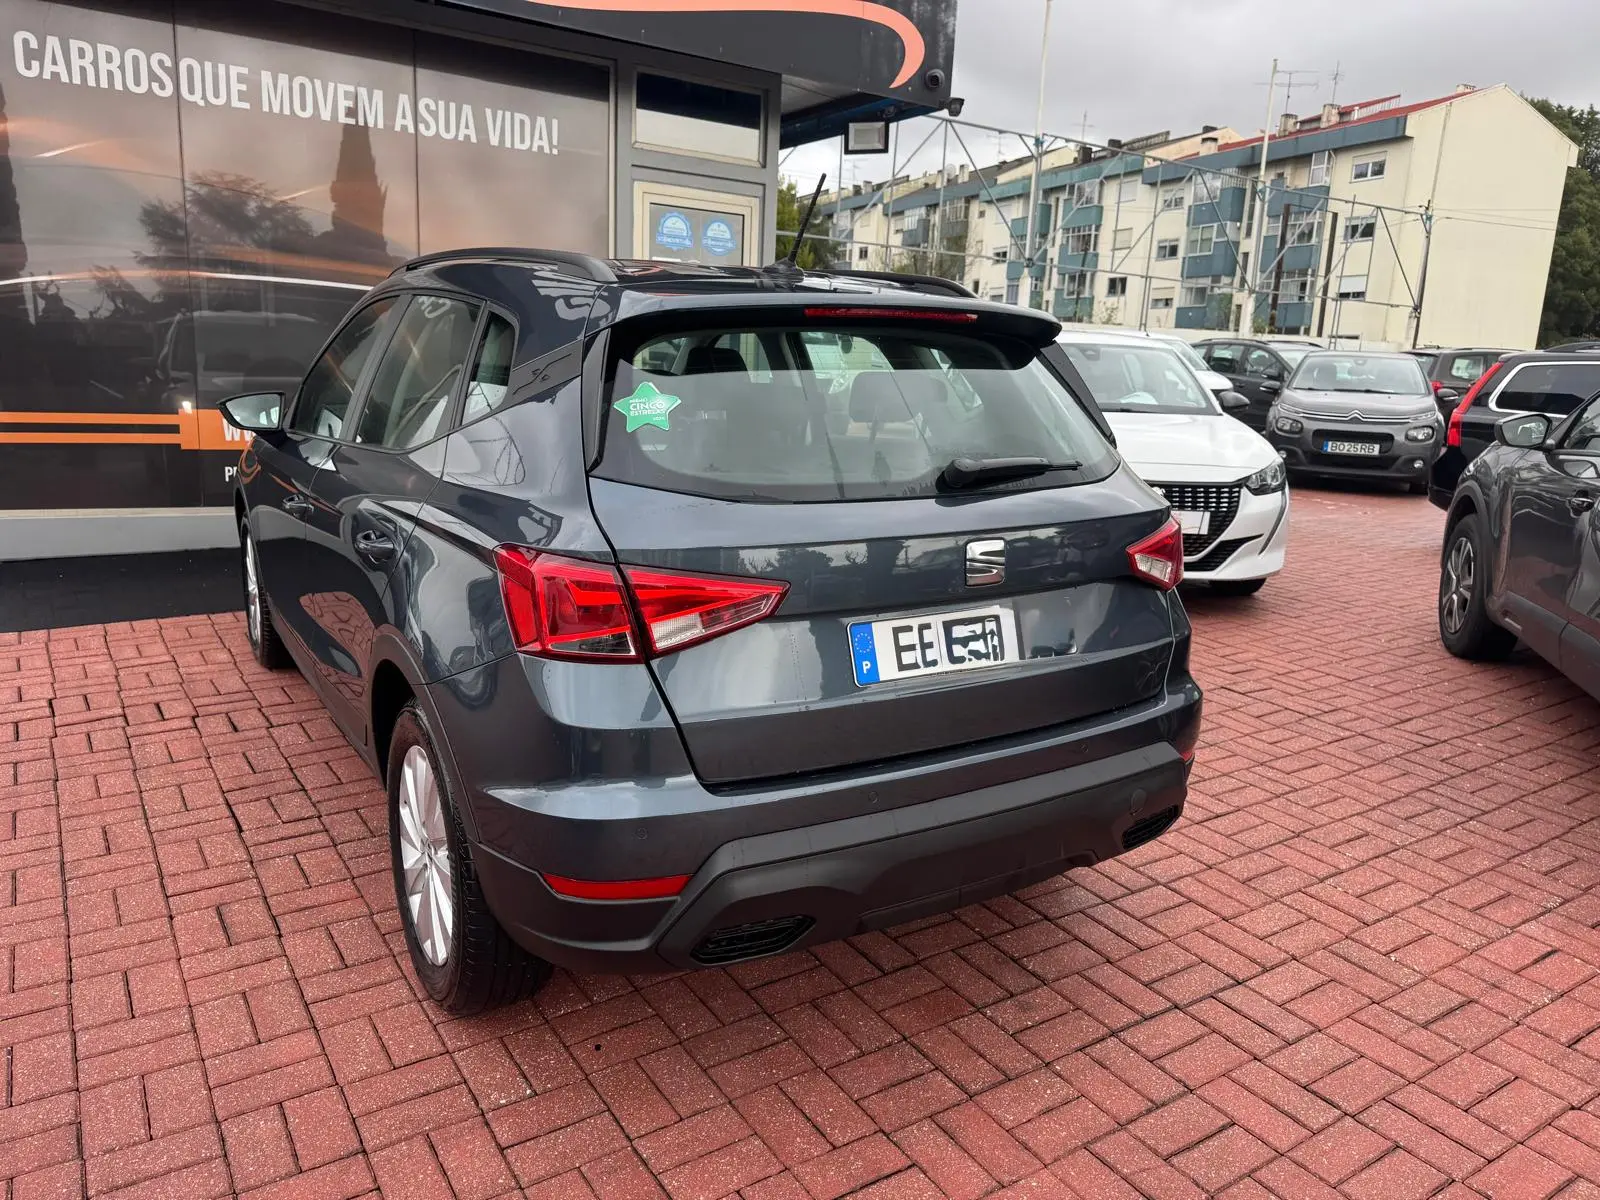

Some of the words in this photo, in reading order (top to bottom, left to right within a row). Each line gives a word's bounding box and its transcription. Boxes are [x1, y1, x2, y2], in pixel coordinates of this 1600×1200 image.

[13, 30, 174, 98] CARROS
[178, 57, 250, 109] QUE
[260, 70, 384, 129] MOVEM
[394, 93, 415, 134] A
[418, 97, 478, 143] SUA
[485, 107, 559, 155] VIDA!
[630, 401, 665, 411] CINCO
[862, 661, 871, 674] P
